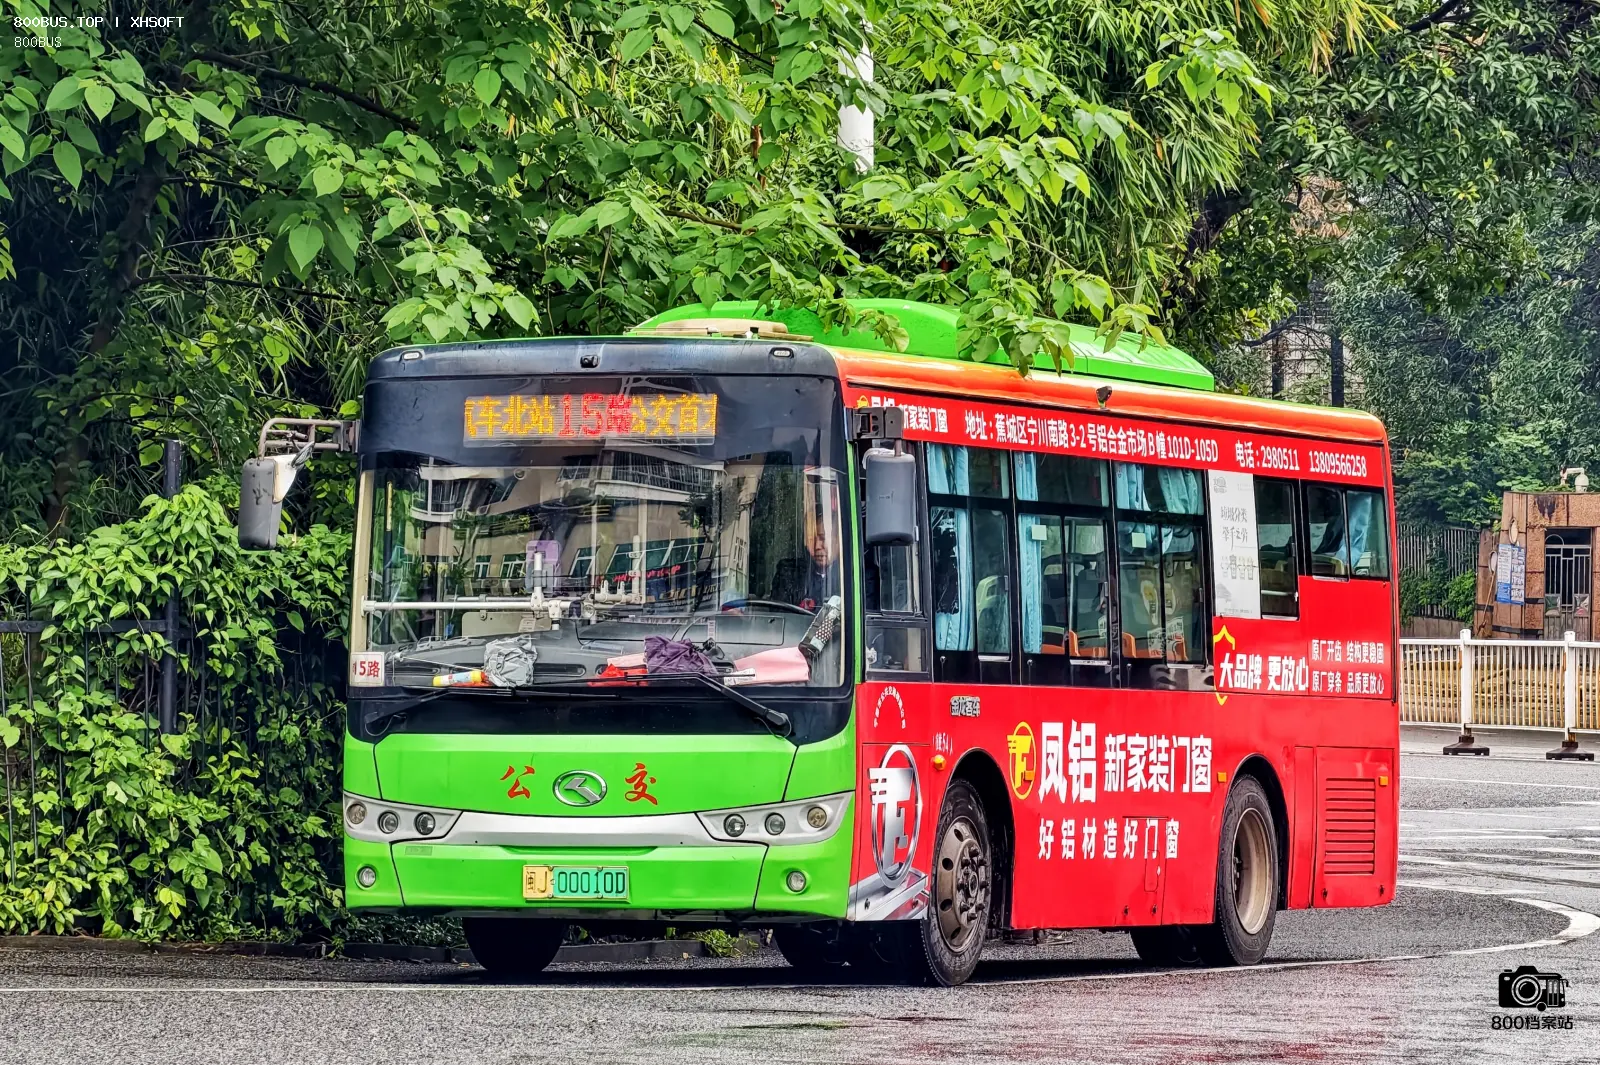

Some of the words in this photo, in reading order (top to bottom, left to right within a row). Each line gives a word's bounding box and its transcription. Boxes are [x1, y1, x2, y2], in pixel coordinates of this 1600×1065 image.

[1235, 440, 1300, 471] 电话：2980511
[1309, 451, 1368, 478] 13809566258
[352, 660, 380, 678] 15路
[1219, 652, 1263, 689] 大品牌
[1267, 656, 1309, 692] 更放心
[1346, 641, 1385, 664] 结构更稳固
[1311, 671, 1343, 693] 原厂穿条
[1346, 672, 1385, 695] 品质更放心
[1038, 719, 1097, 803] 凤铝
[1104, 733, 1212, 793] 新家装门窗
[500, 765, 535, 799] 公
[625, 763, 658, 805] 交
[1038, 818, 1180, 860] 好铝材造好门窗
